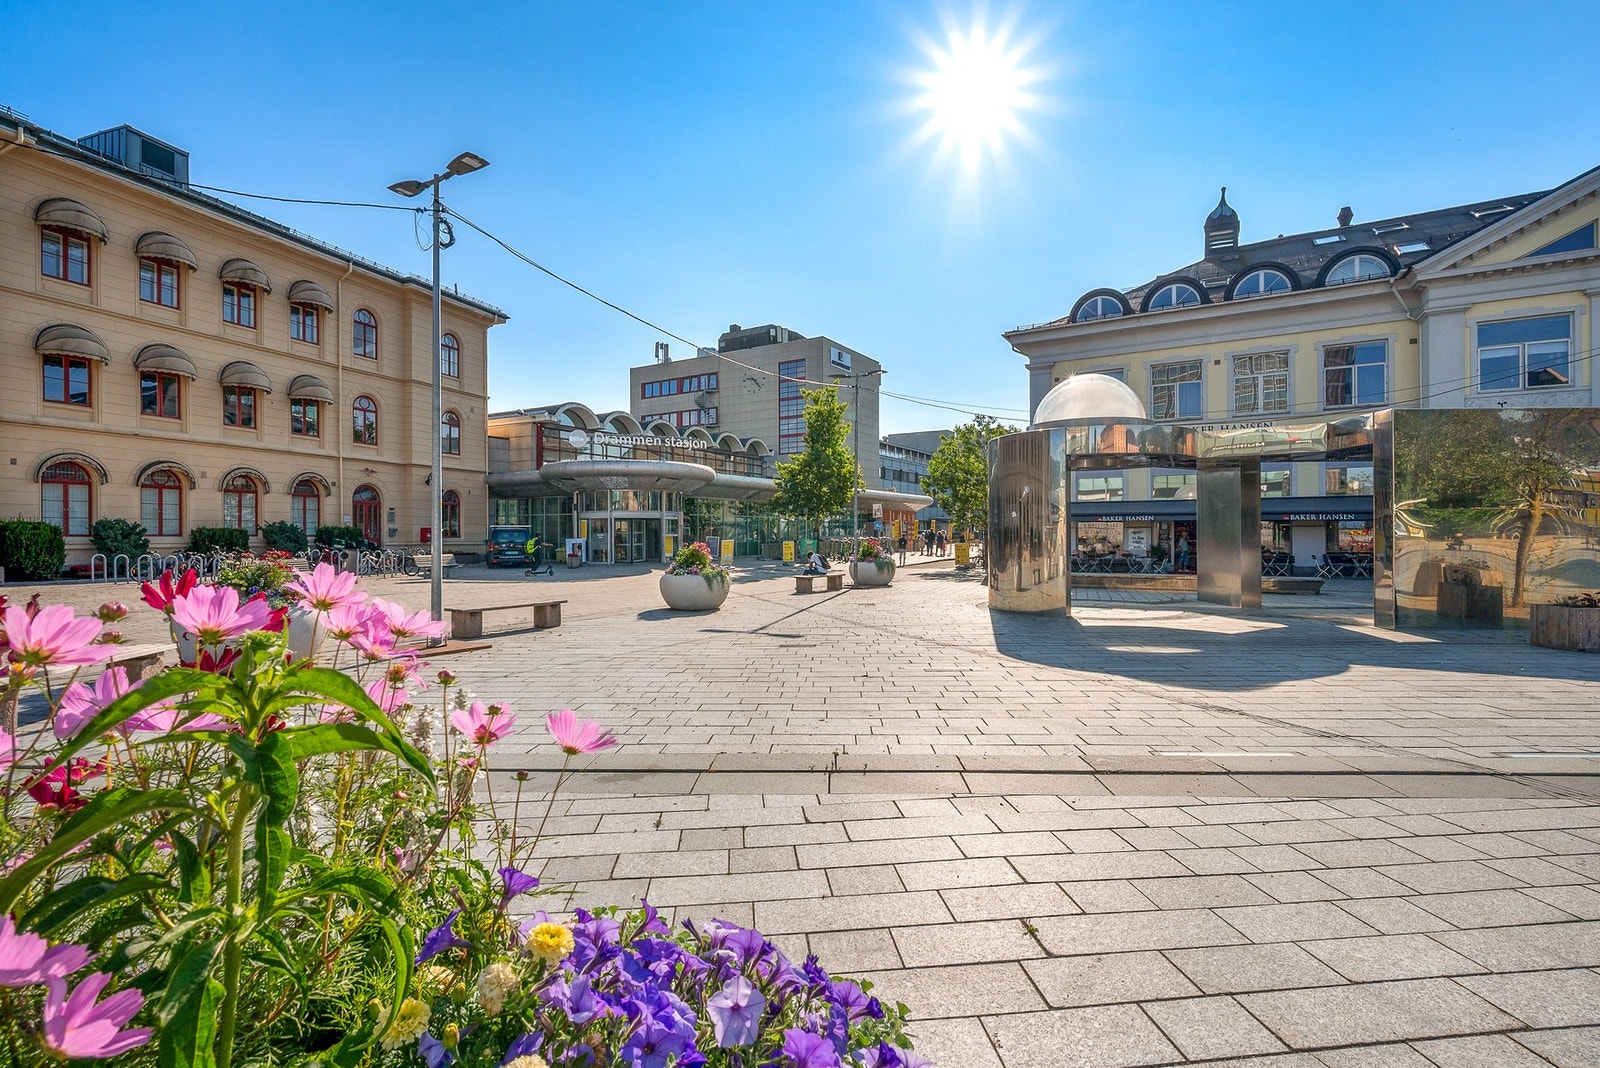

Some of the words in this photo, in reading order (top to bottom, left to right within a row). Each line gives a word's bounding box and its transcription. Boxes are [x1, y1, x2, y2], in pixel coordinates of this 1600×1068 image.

[1220, 421, 1273, 431] HANSEN
[594, 431, 661, 447] Drammen
[664, 435, 708, 451] stasjon
